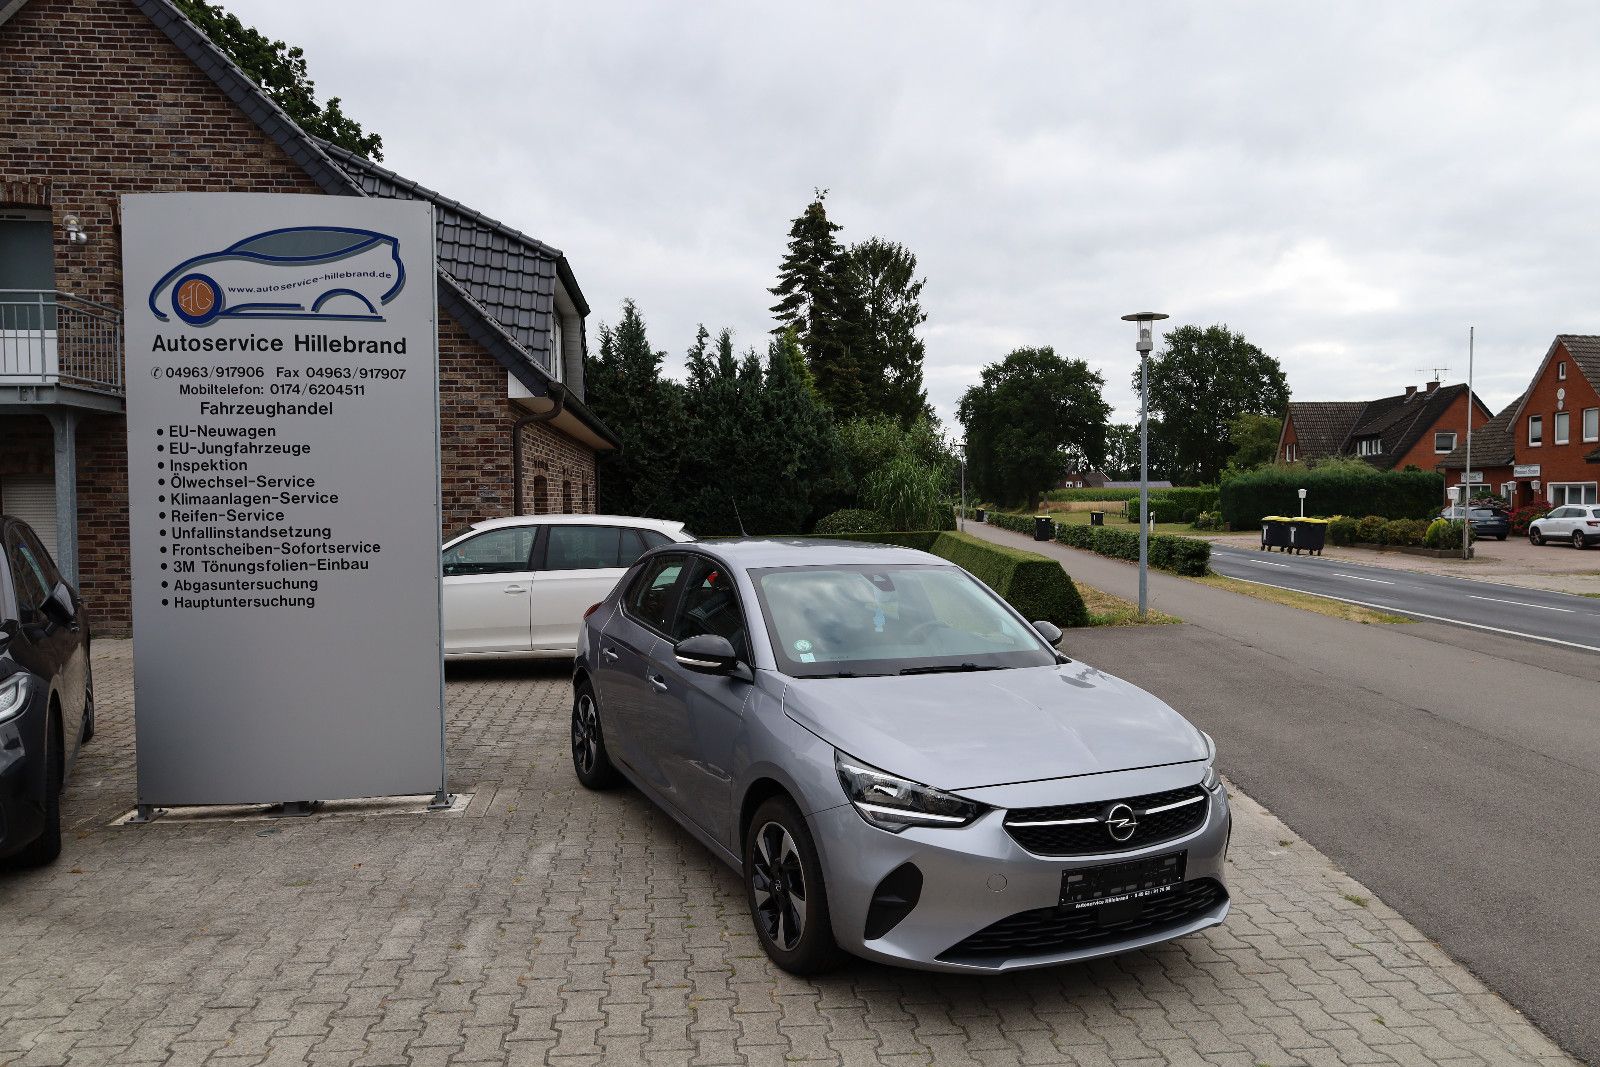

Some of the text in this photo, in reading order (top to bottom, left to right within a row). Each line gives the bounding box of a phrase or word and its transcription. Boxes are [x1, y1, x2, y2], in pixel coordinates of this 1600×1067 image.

[228, 271, 392, 293] www.autoservice-hillebrand.de
[151, 333, 407, 355] Autoservice Hillebrand
[165, 366, 407, 381] 04963/917906 Fax 04963/917907
[179, 384, 365, 397] Mobiltelefon: 0174/6204511
[200, 401, 333, 418] Fahrzeughandel
[169, 425, 276, 440] EU-Neuwagen
[169, 442, 311, 457] EU-Jungfahrzeuge
[170, 459, 248, 474] Inspektion
[170, 473, 316, 489] Ölwechsel-Service
[171, 491, 339, 507] Klimaanlagen-Service
[171, 509, 285, 522] Reifen-Service
[172, 526, 332, 540] Unfallinstandsetzung
[172, 541, 381, 556] Frontscheiben-Sofortservice
[173, 558, 369, 574] 3M Tönungsfolien-Einbau
[174, 578, 319, 593] Abgasuntersuchung
[174, 595, 315, 611] Hauptuntersuchung
